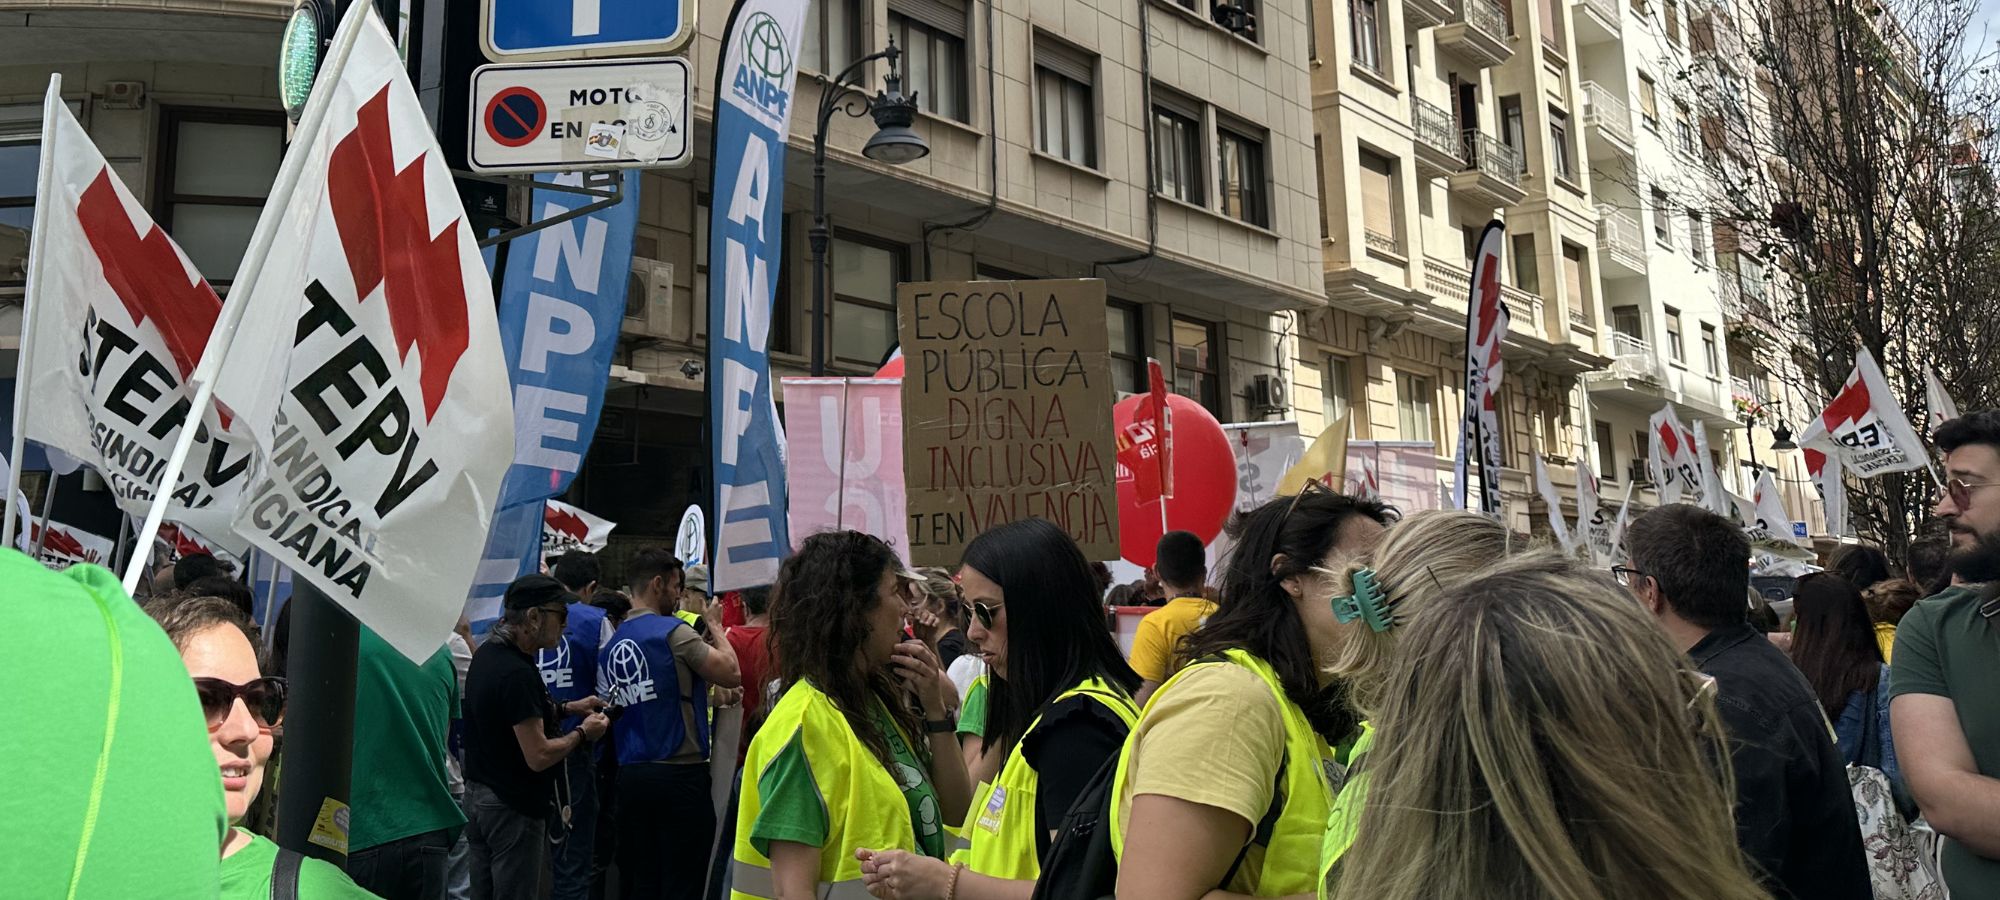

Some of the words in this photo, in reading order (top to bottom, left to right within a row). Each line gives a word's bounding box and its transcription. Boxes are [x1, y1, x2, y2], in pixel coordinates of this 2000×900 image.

[569, 87, 643, 106] MOTO
[551, 121, 582, 139] EN
[914, 292, 1068, 341] ESCOLA
[292, 278, 439, 519] TEPV
[948, 393, 1070, 441] DIGNA
[932, 511, 964, 546] EN
